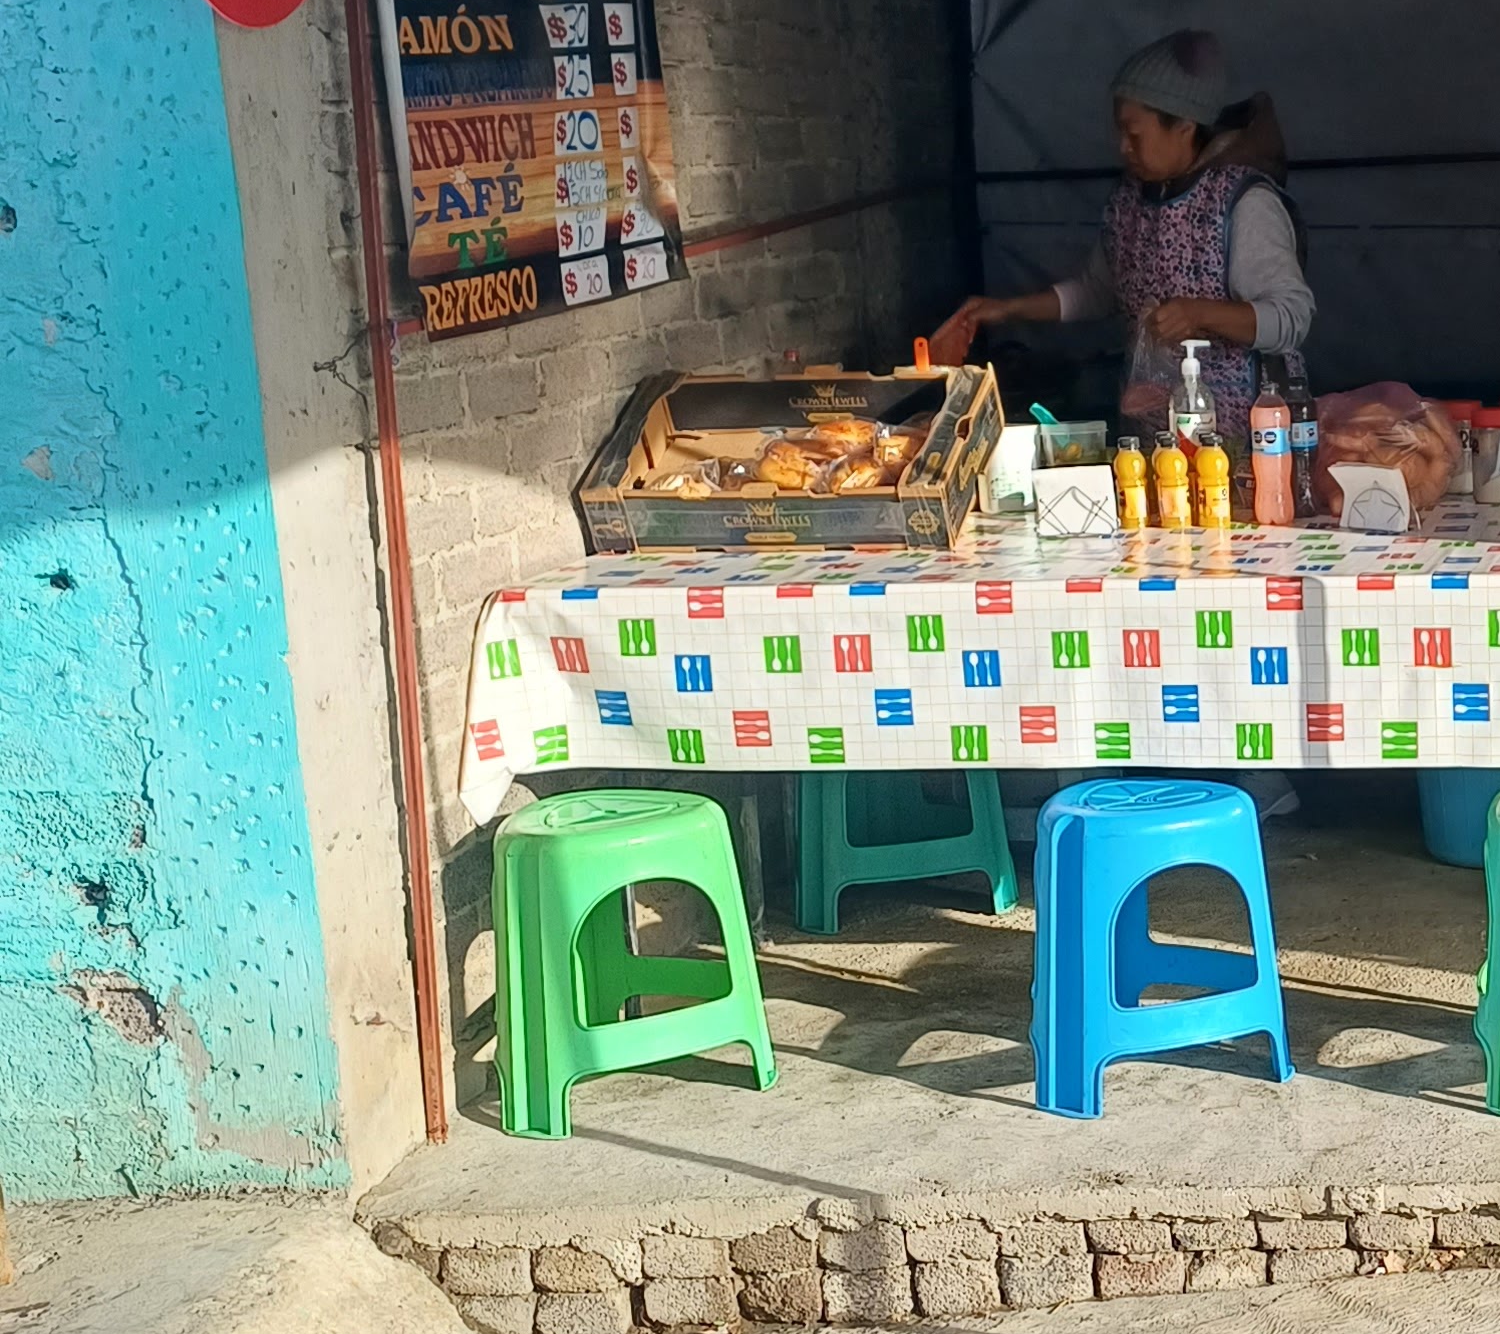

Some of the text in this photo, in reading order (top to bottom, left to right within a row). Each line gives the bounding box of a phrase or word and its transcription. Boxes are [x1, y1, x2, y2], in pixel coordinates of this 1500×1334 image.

[556, 110, 599, 152] $20
[448, 218, 508, 269] TÉ
[419, 265, 538, 331] REFRESCO
[723, 514, 767, 527] CROWN
